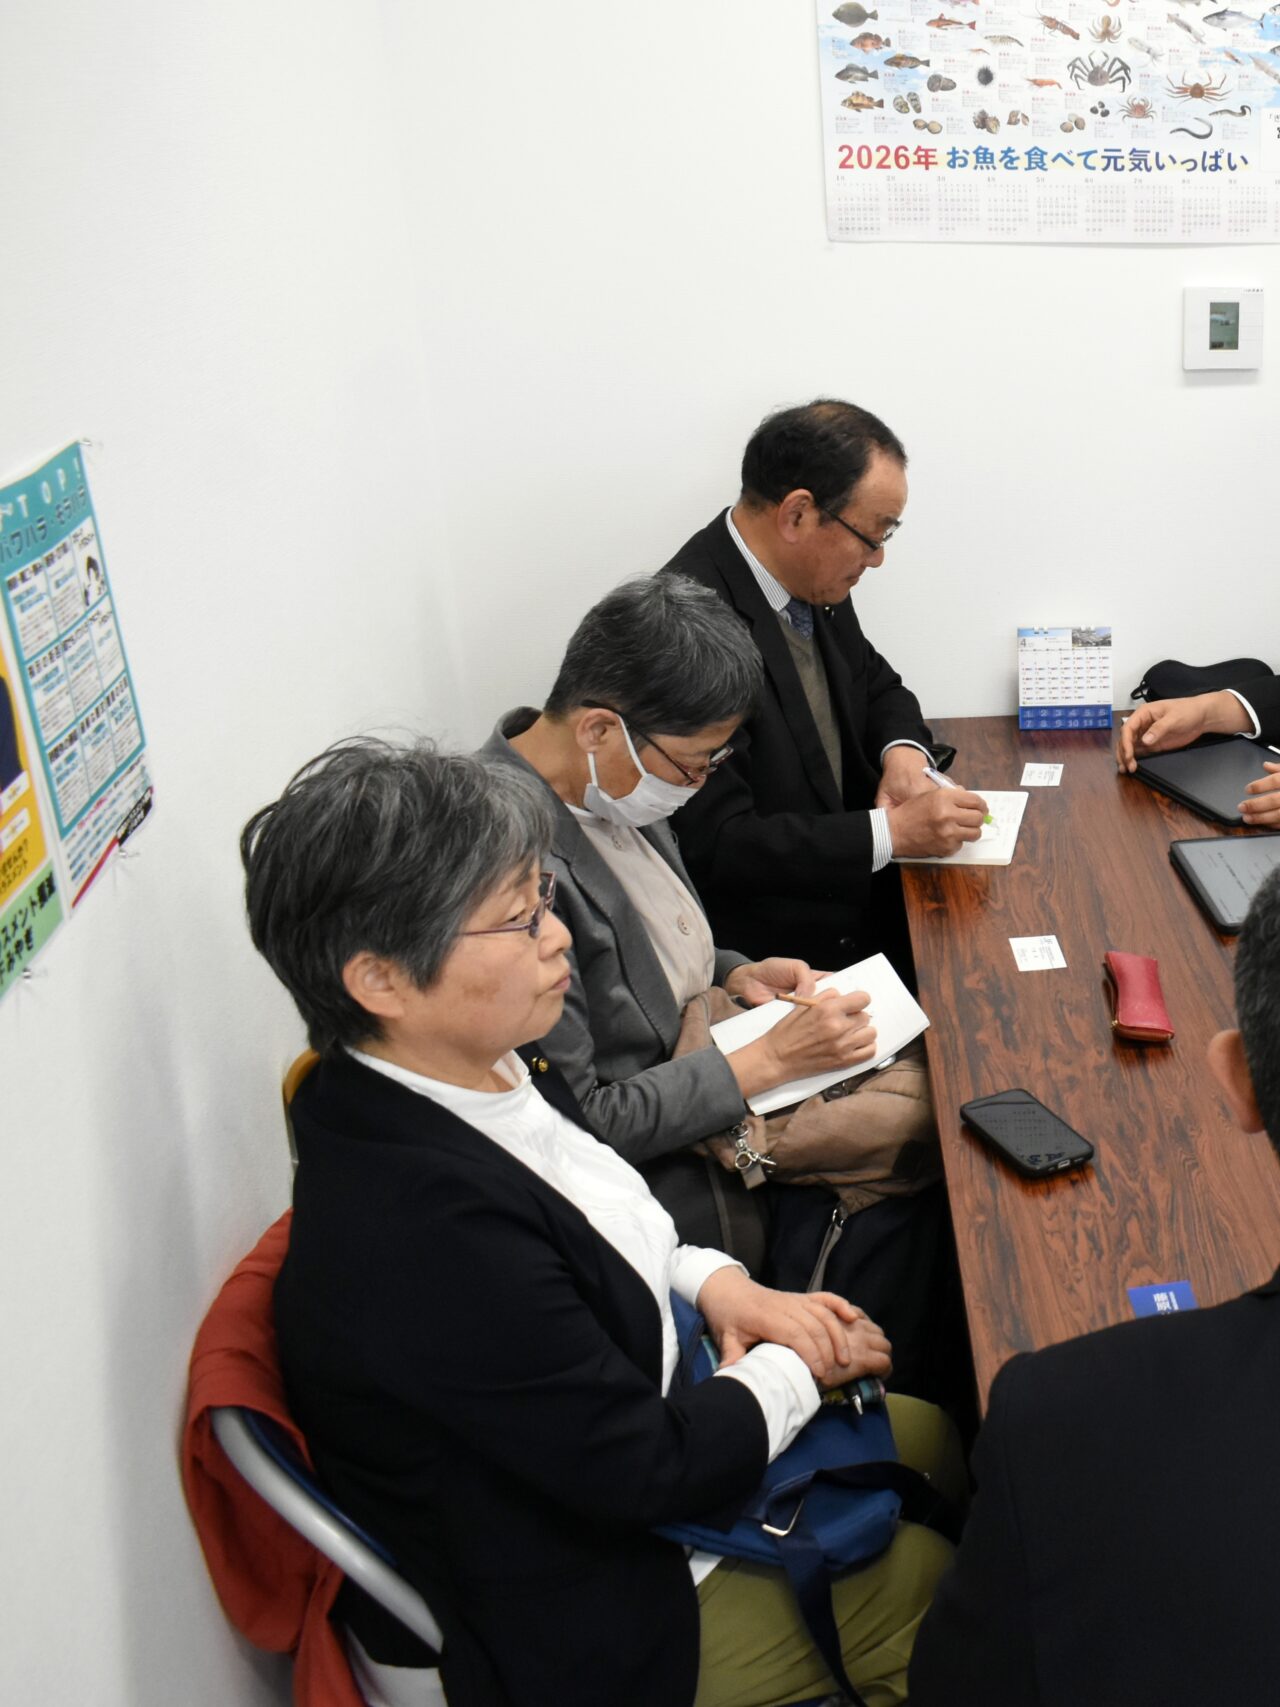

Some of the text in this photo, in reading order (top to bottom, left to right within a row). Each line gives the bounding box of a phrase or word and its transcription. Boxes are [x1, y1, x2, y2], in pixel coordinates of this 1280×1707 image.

[838, 144, 1249, 173] 2026年 お魚を食べて元気いっぱい
